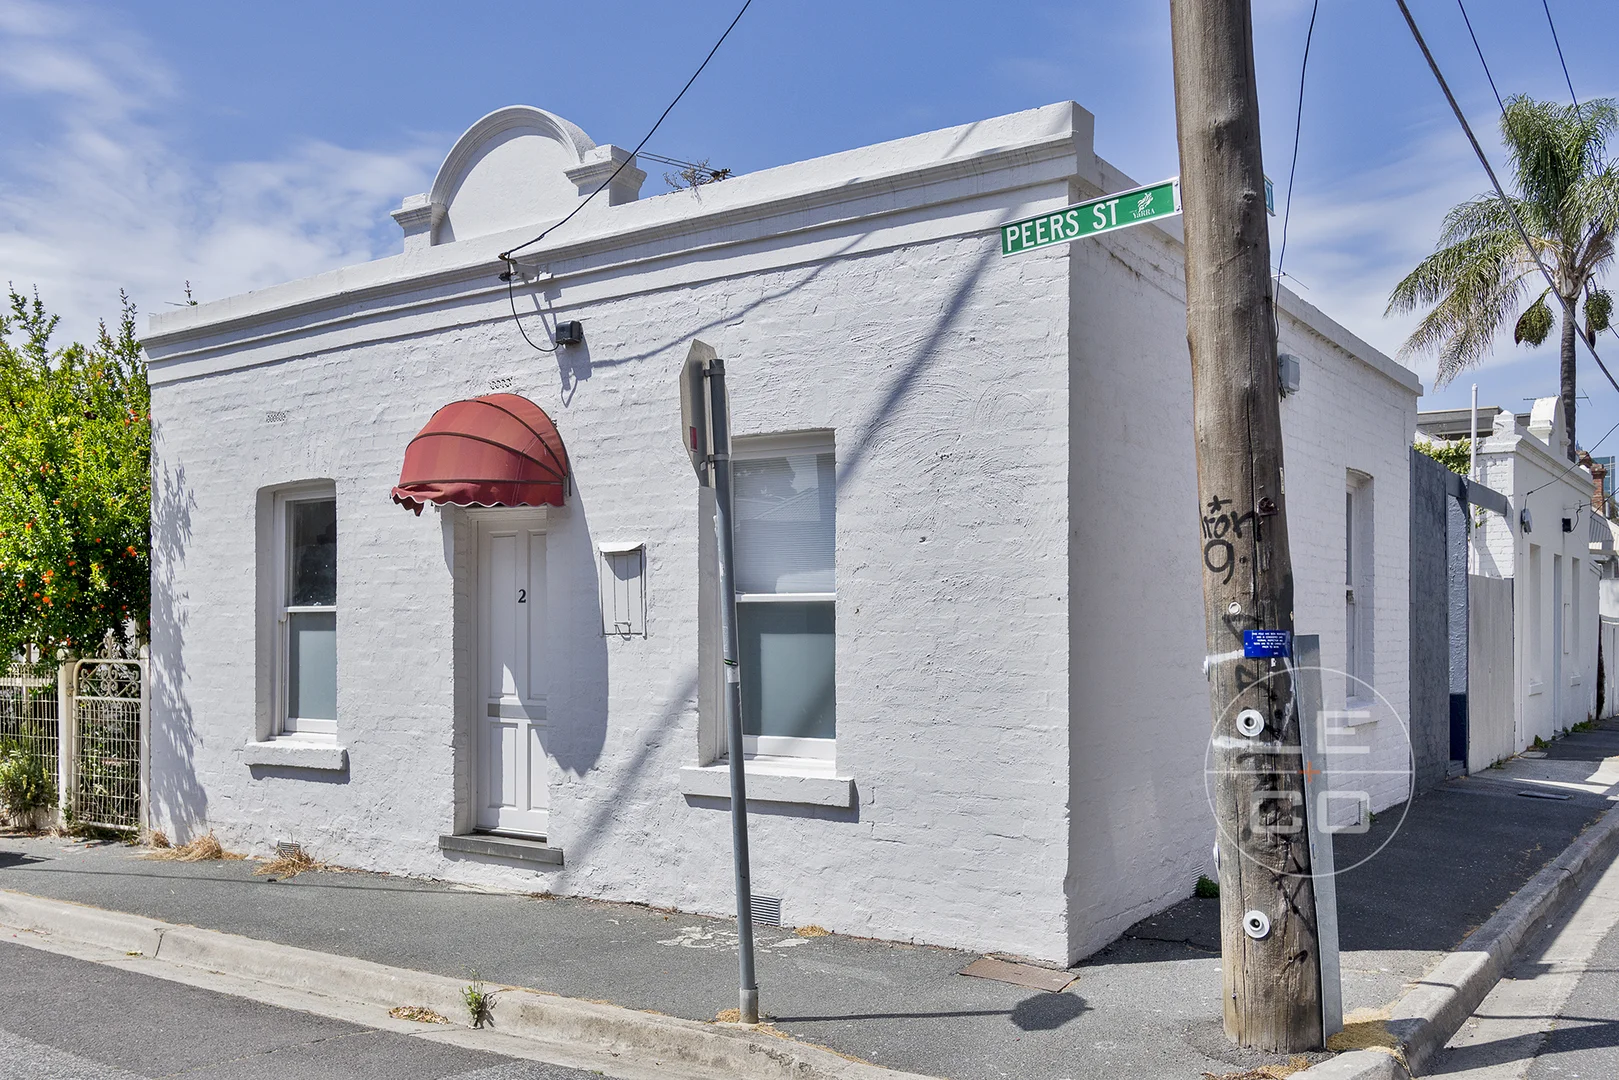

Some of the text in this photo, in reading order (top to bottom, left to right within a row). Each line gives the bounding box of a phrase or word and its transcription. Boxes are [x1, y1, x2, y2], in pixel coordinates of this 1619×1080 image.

[1006, 199, 1119, 251] PEERS ST
[517, 588, 527, 604] 2
